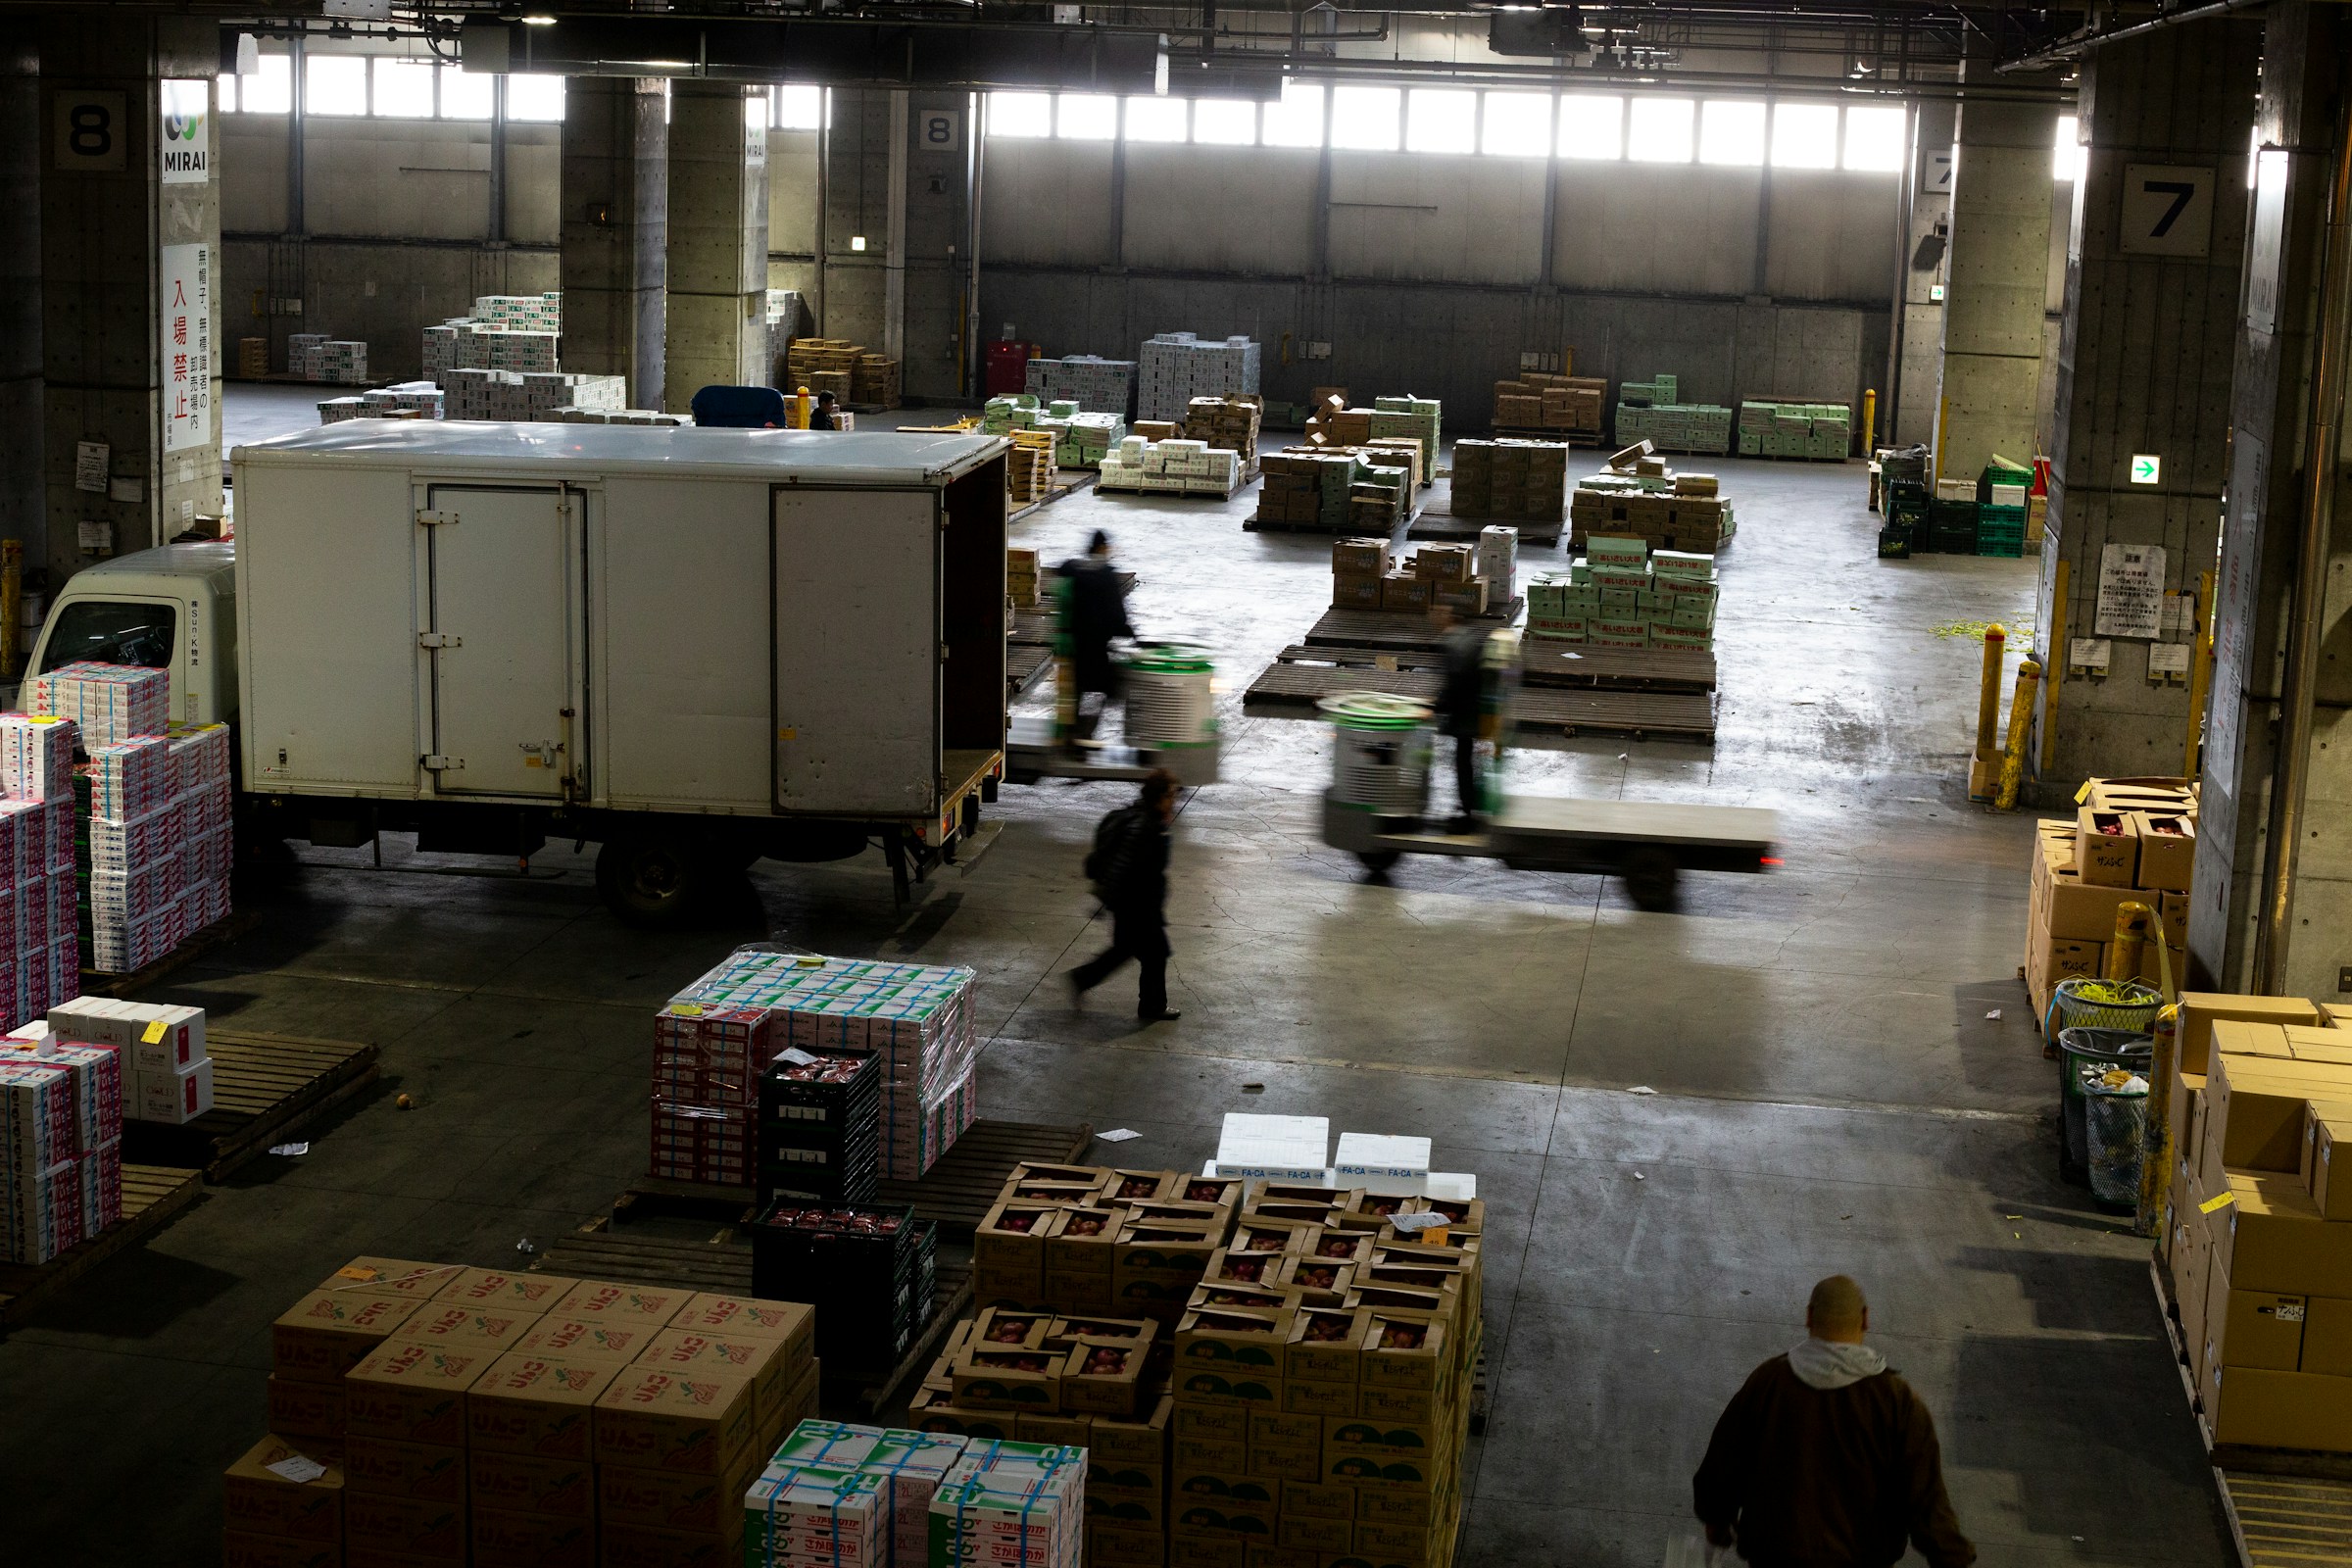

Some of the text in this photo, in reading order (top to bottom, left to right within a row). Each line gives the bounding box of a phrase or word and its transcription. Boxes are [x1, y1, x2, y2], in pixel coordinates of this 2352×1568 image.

[70, 104, 111, 156] 8
[927, 118, 951, 143] 8
[747, 145, 764, 158] MIRAI
[165, 151, 206, 172] MIRAI
[2143, 180, 2194, 237] 7
[2252, 276, 2276, 315] MIRAI
[173, 279, 188, 419] 入場禁止
[190, 356, 199, 430] 卸売場内
[2097, 856, 2126, 867] サンふじ
[2176, 916, 2186, 926] サン
[2061, 959, 2089, 971] サンふじ
[1242, 1168, 1265, 1178] FA-CA
[1288, 1170, 1311, 1180] FA-CA
[1343, 1166, 1366, 1176] FA-CA
[1388, 1168, 1411, 1178] FA-CA
[902, 1486, 912, 1497] 2L
[898, 1512, 908, 1525] 2L
[897, 1537, 907, 1549] 2L
